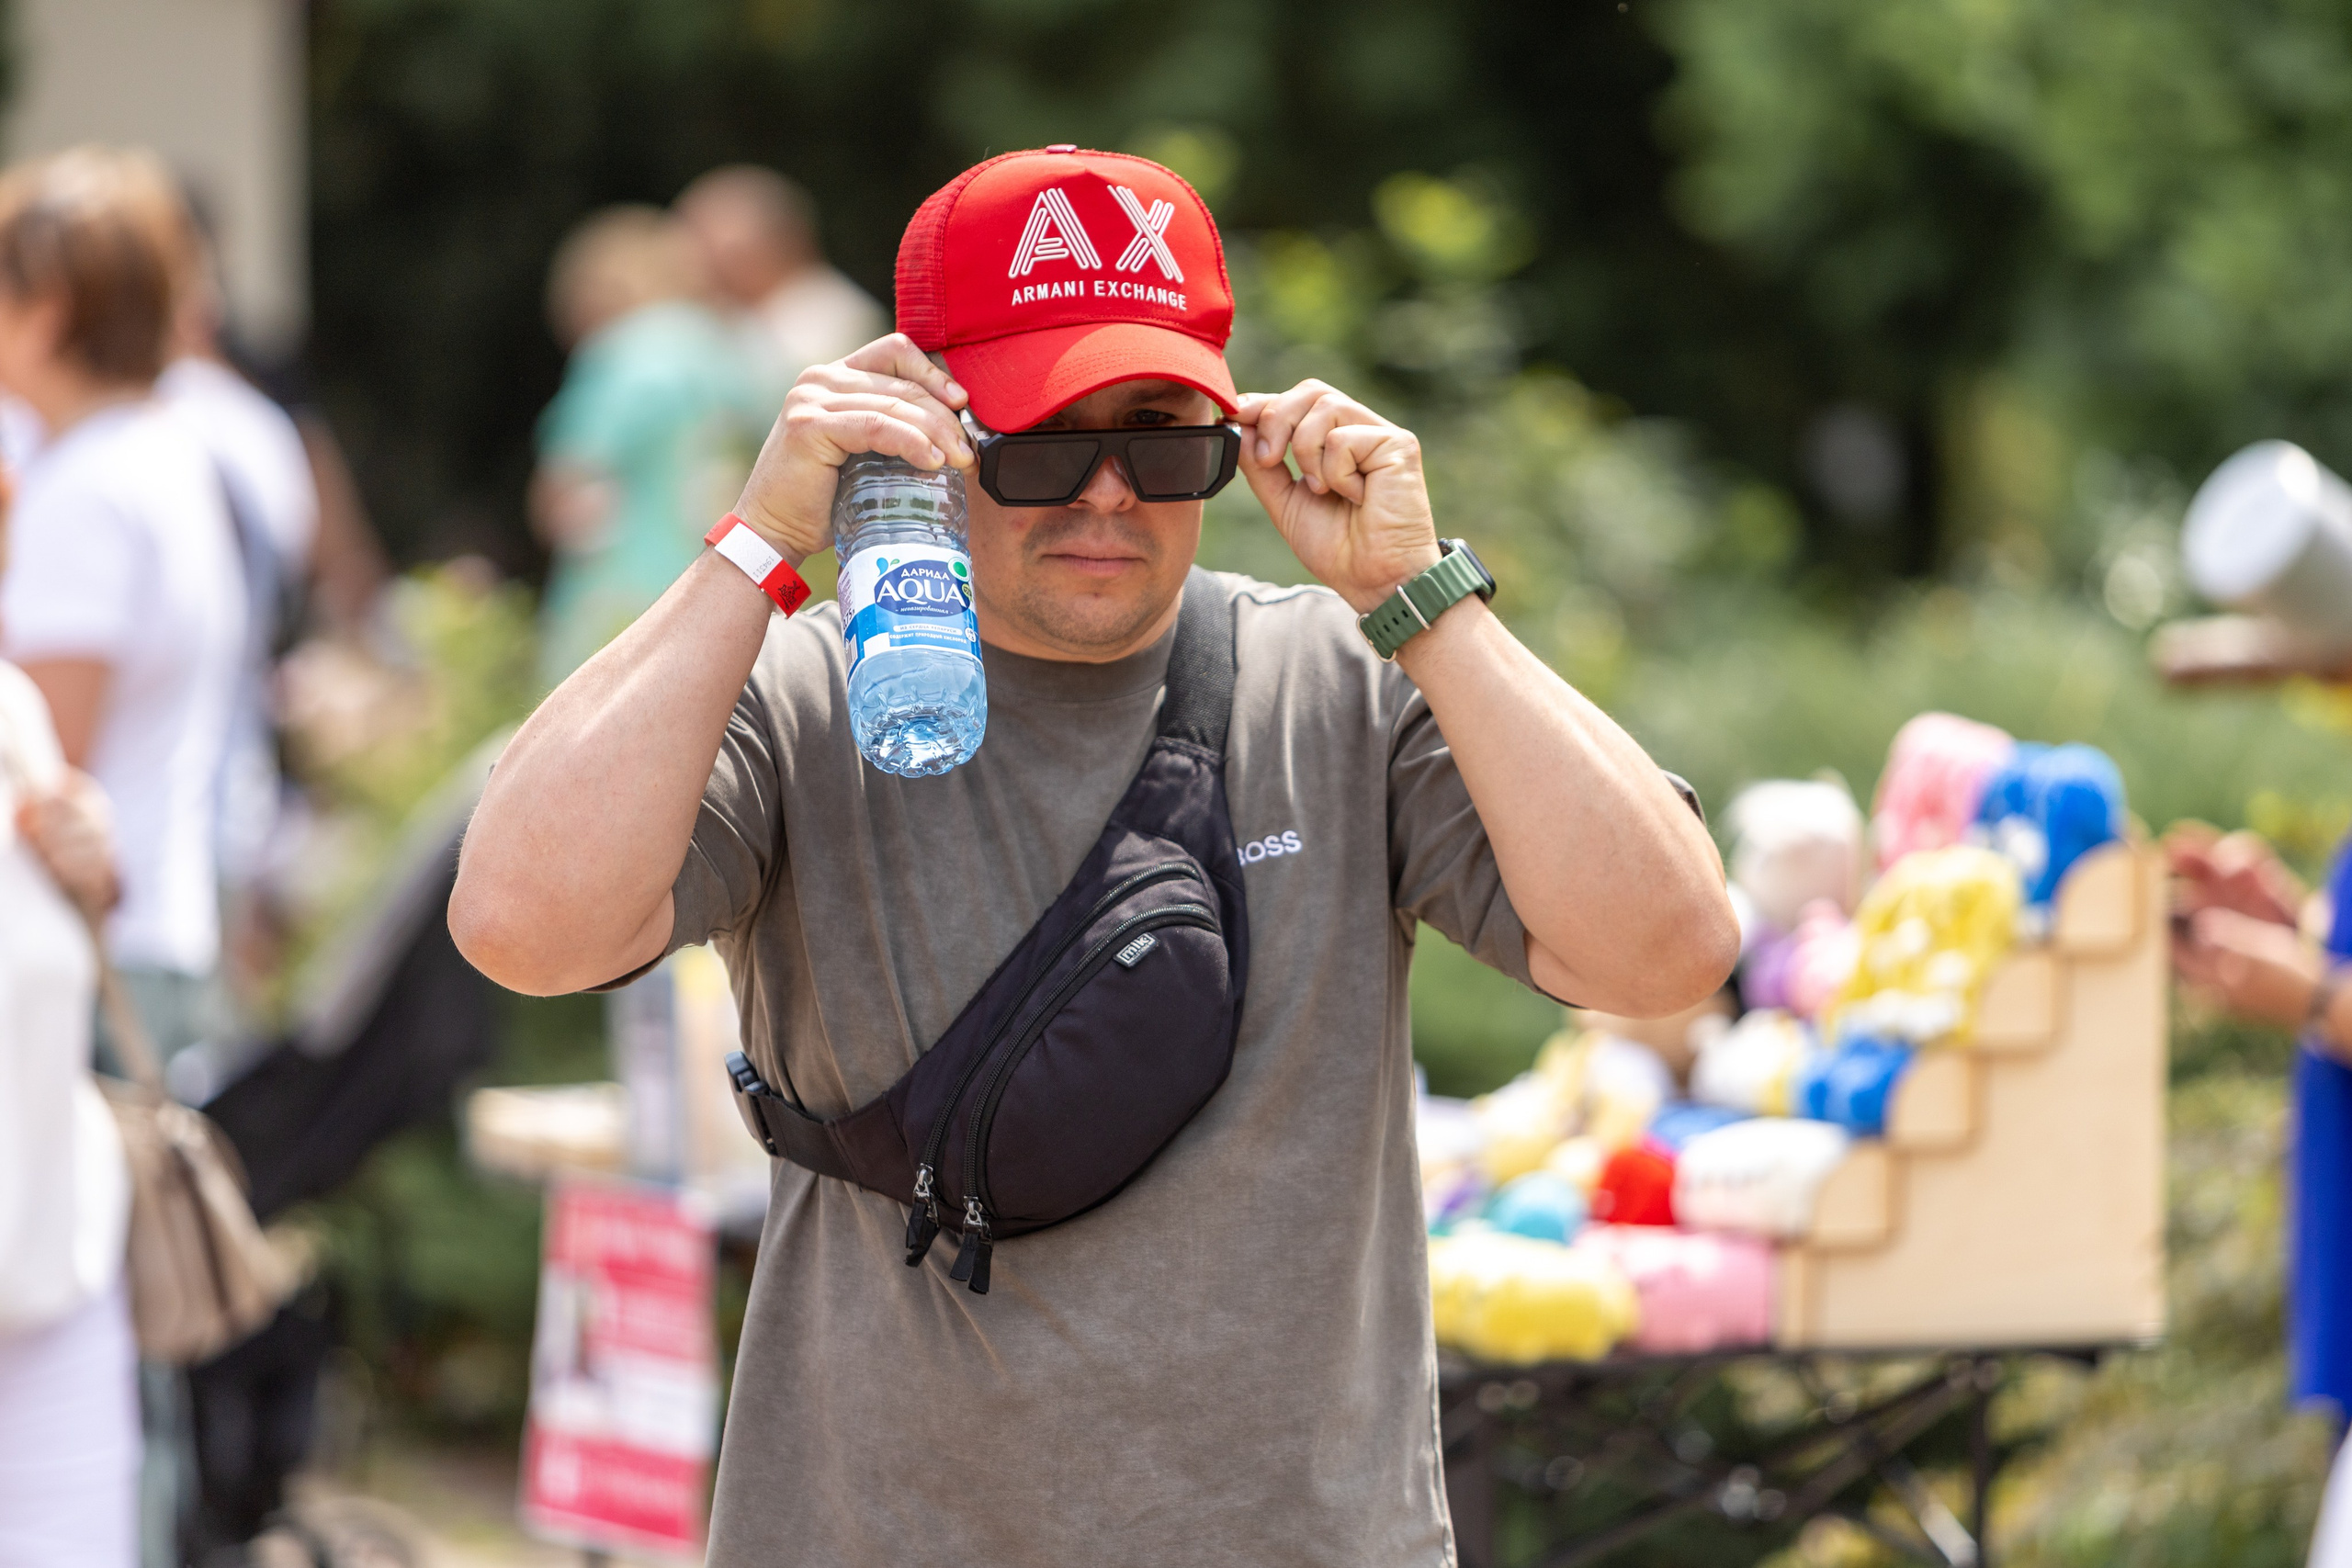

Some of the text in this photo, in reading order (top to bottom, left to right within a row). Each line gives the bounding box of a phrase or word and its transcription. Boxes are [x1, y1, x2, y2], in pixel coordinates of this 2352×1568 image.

[1008, 185, 1184, 283] AX
[1012, 280, 1188, 310] ARMANI EXCHANGE
[900, 568, 950, 581] ДАРИДА
[876, 578, 967, 607] AQUA
